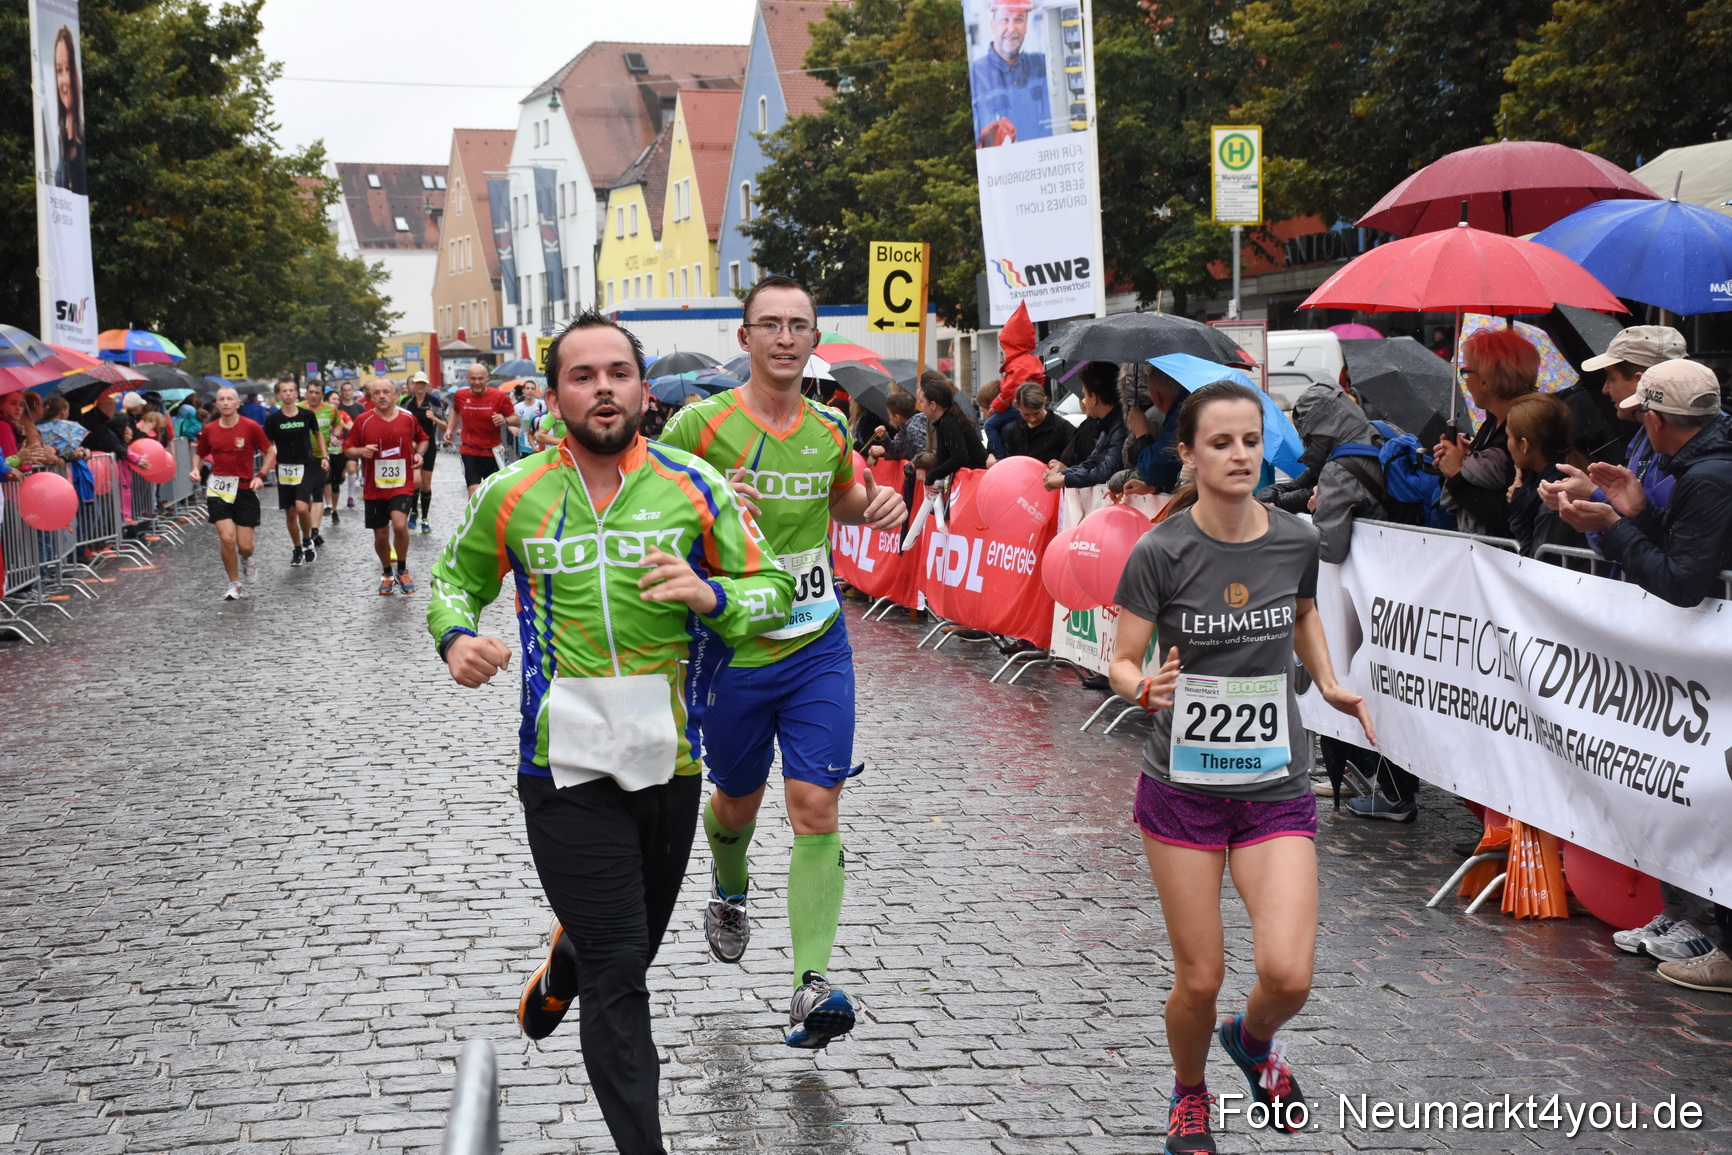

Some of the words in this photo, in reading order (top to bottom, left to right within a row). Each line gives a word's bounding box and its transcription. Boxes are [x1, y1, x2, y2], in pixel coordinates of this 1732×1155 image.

[877, 246, 922, 262] Block
[883, 269, 913, 313] C
[227, 354, 240, 371] D
[279, 421, 305, 430] adidas
[283, 467, 298, 476] 151
[381, 466, 400, 478] 233
[213, 479, 231, 492] 201
[522, 528, 685, 574] BOCK
[1181, 606, 1293, 634] LEHMEIER
[1370, 596, 1424, 656] BMW
[1188, 638, 1223, 646] Anwalts-
[1225, 636, 1241, 645] und
[1241, 630, 1289, 644] Steuerkanzlei
[1184, 686, 1220, 695] NeuerMarkt
[1226, 679, 1279, 694] BOCK
[1184, 701, 1278, 743] 2229
[1369, 660, 1425, 711] WENIGER
[1427, 678, 1533, 742] VERBRAUCH.
[1566, 728, 1692, 807] FAHRFREUDE.
[1200, 752, 1262, 770] Theresa
